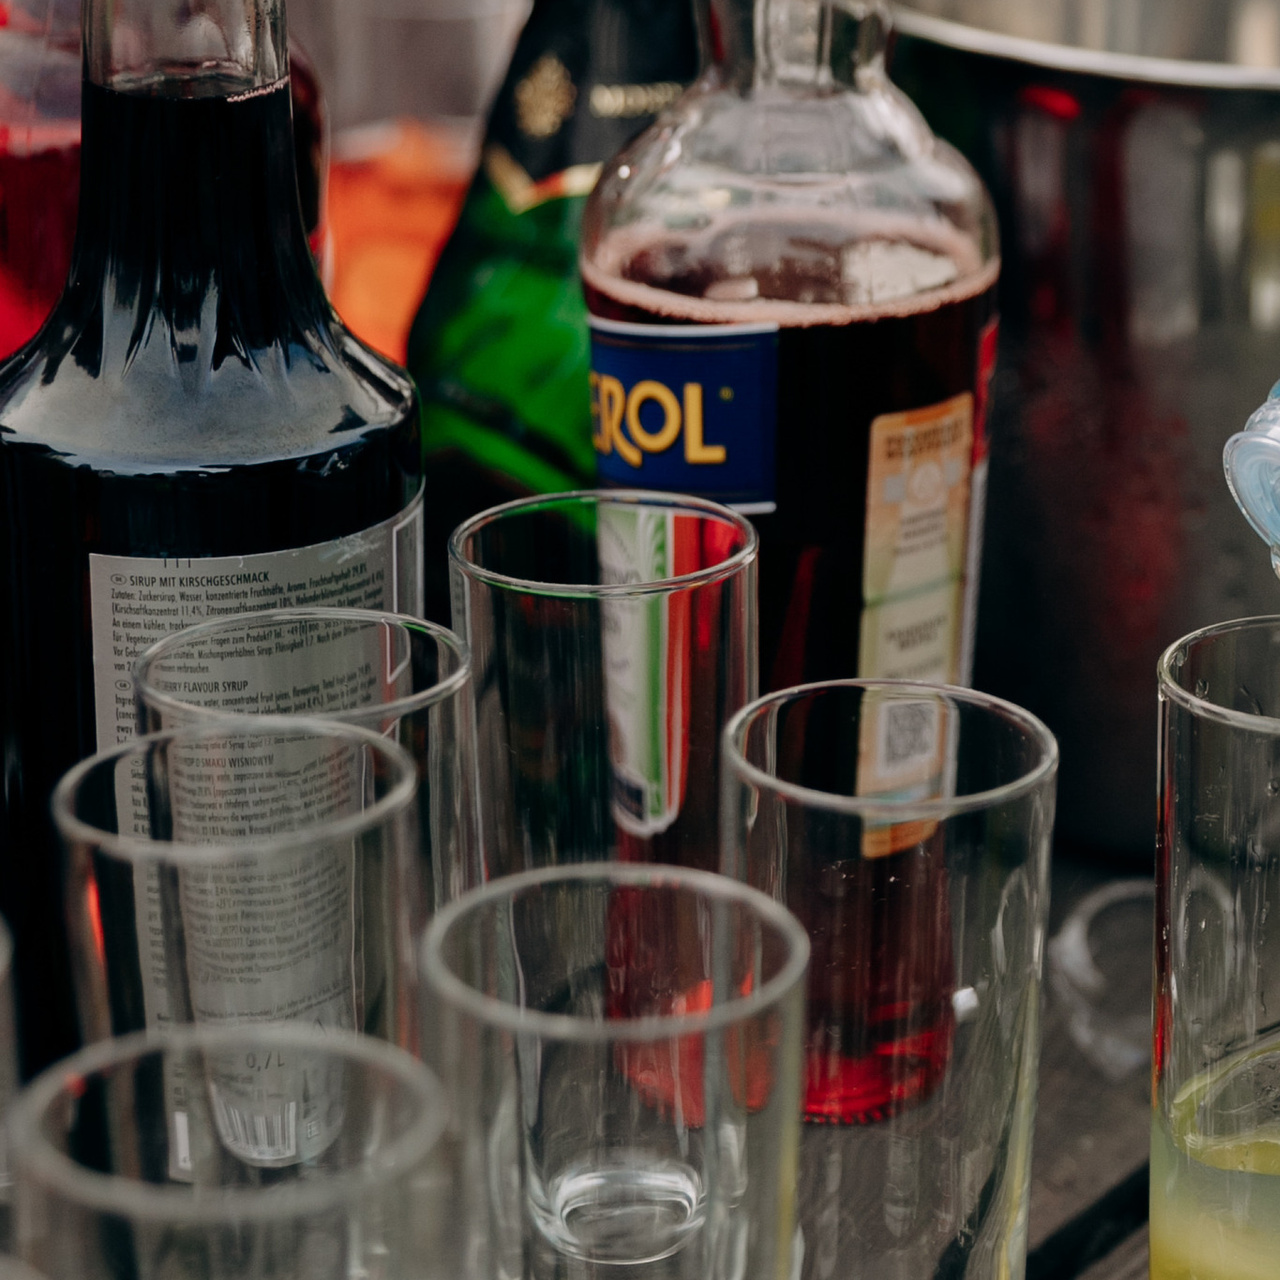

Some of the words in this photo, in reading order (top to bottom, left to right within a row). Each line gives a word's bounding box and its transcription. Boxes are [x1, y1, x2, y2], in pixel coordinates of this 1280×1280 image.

[130, 576, 157, 587] SIRUP
[160, 577, 176, 587] MIT
[180, 571, 269, 587] KIRSCHGESCHMACK
[206, 589, 248, 601] konzentrierte
[112, 620, 121, 628] An
[122, 621, 141, 629] einem
[143, 620, 167, 632] kühlen,
[210, 635, 231, 647] Fragen
[232, 634, 244, 643] zum
[113, 647, 123, 655] Vor
[183, 681, 220, 693] FLAVOUR
[222, 680, 249, 691] SYRUP
